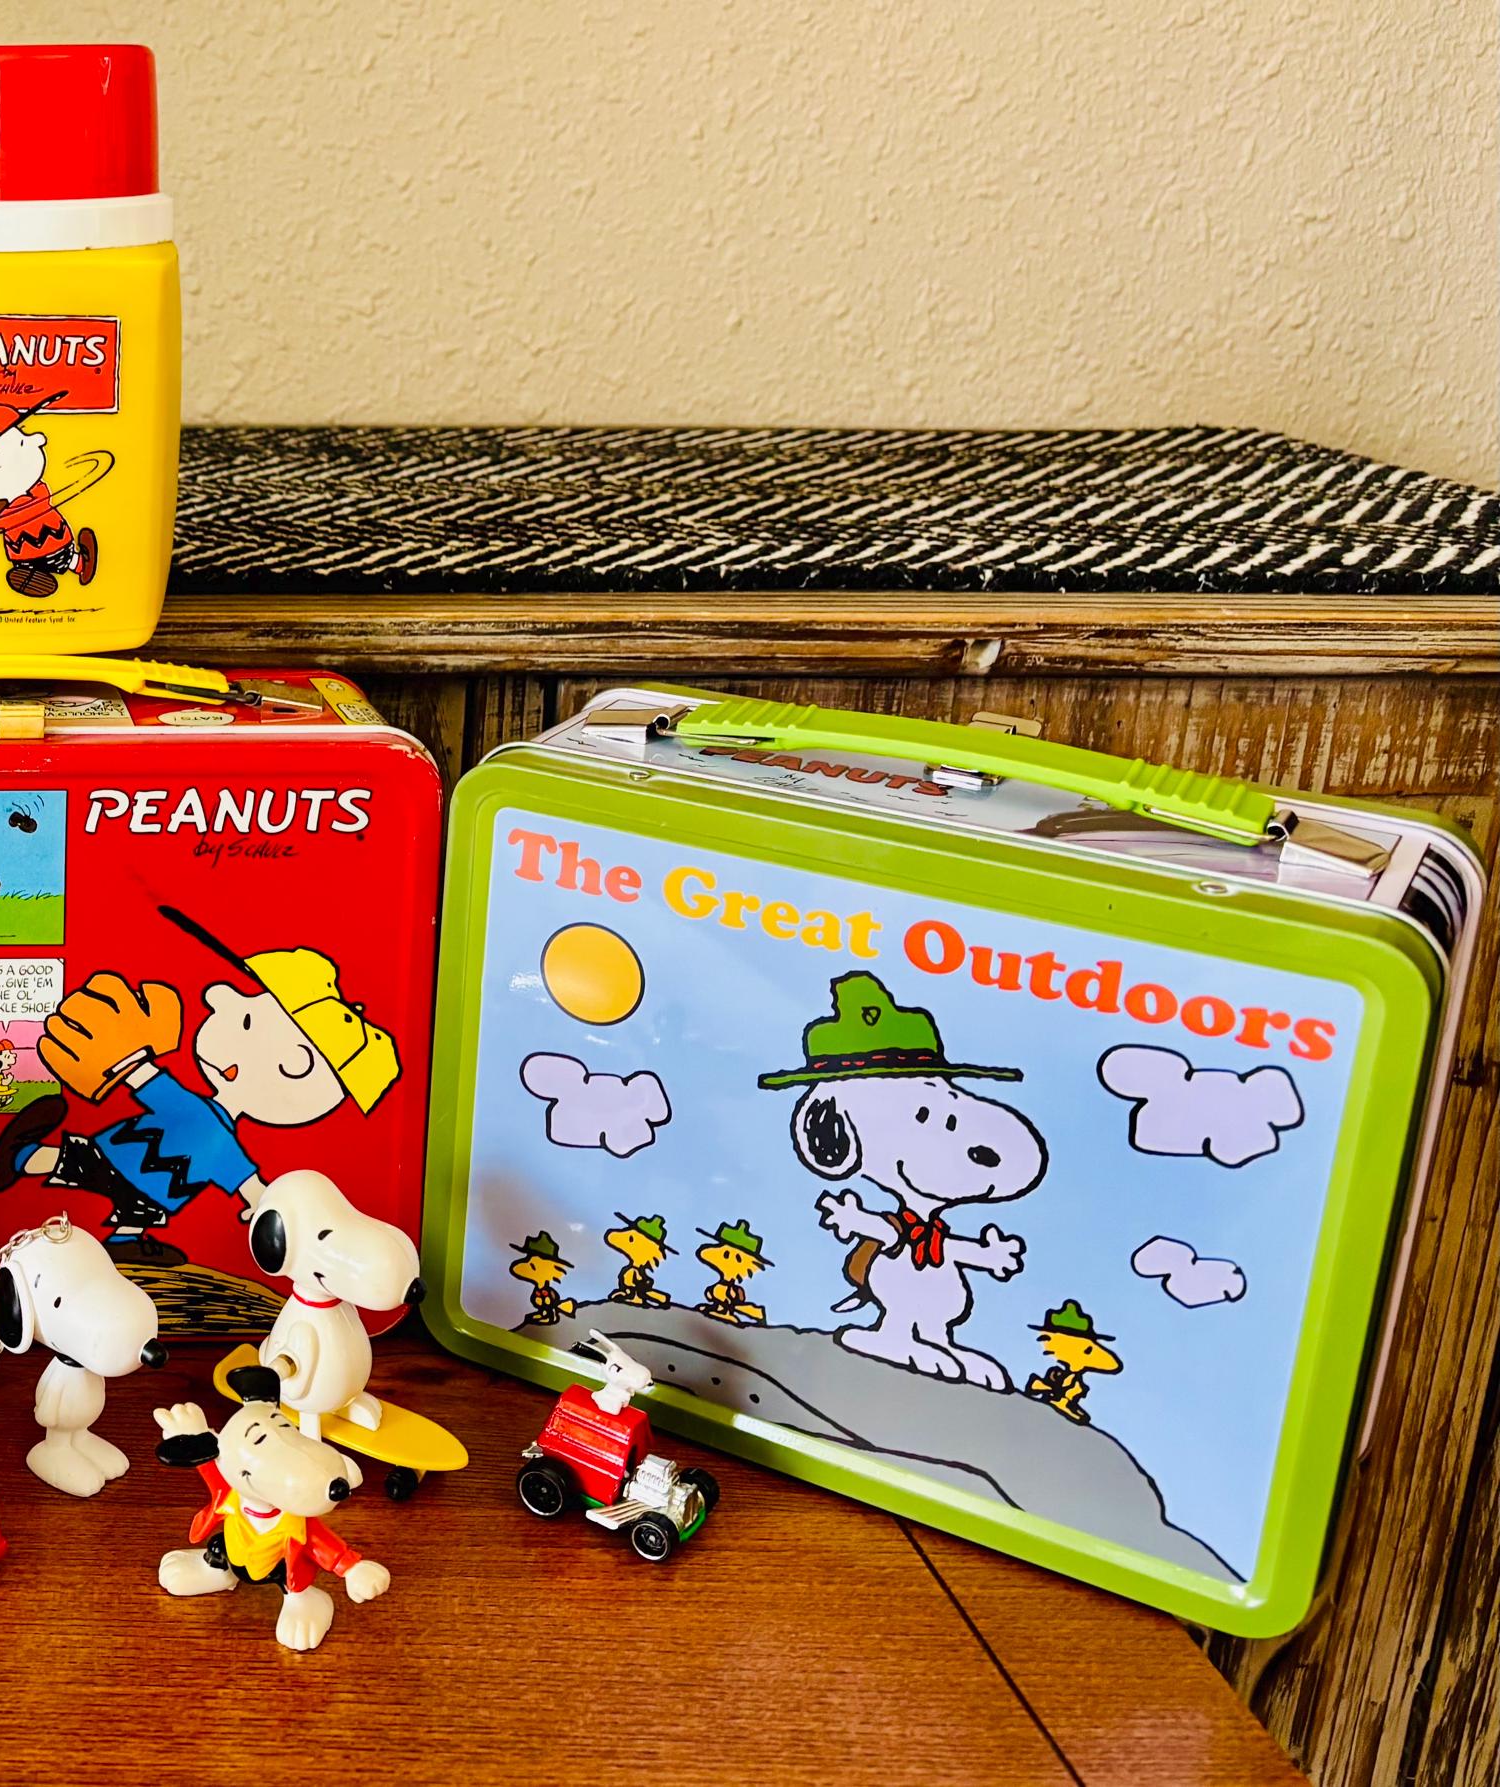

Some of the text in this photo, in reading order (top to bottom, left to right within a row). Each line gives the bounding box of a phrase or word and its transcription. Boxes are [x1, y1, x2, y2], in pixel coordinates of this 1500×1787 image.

[699, 747, 953, 797] PEANUTS
[84, 787, 372, 834] PEANUTS
[193, 833, 220, 868] by
[507, 827, 1337, 1063] The Great Outdoors
[6, 965, 16, 976] A
[18, 965, 53, 976] GOOD
[33, 977, 53, 988] 'EM
[16, 990, 36, 1000] OL'
[21, 1002, 56, 1014] SHOE!
